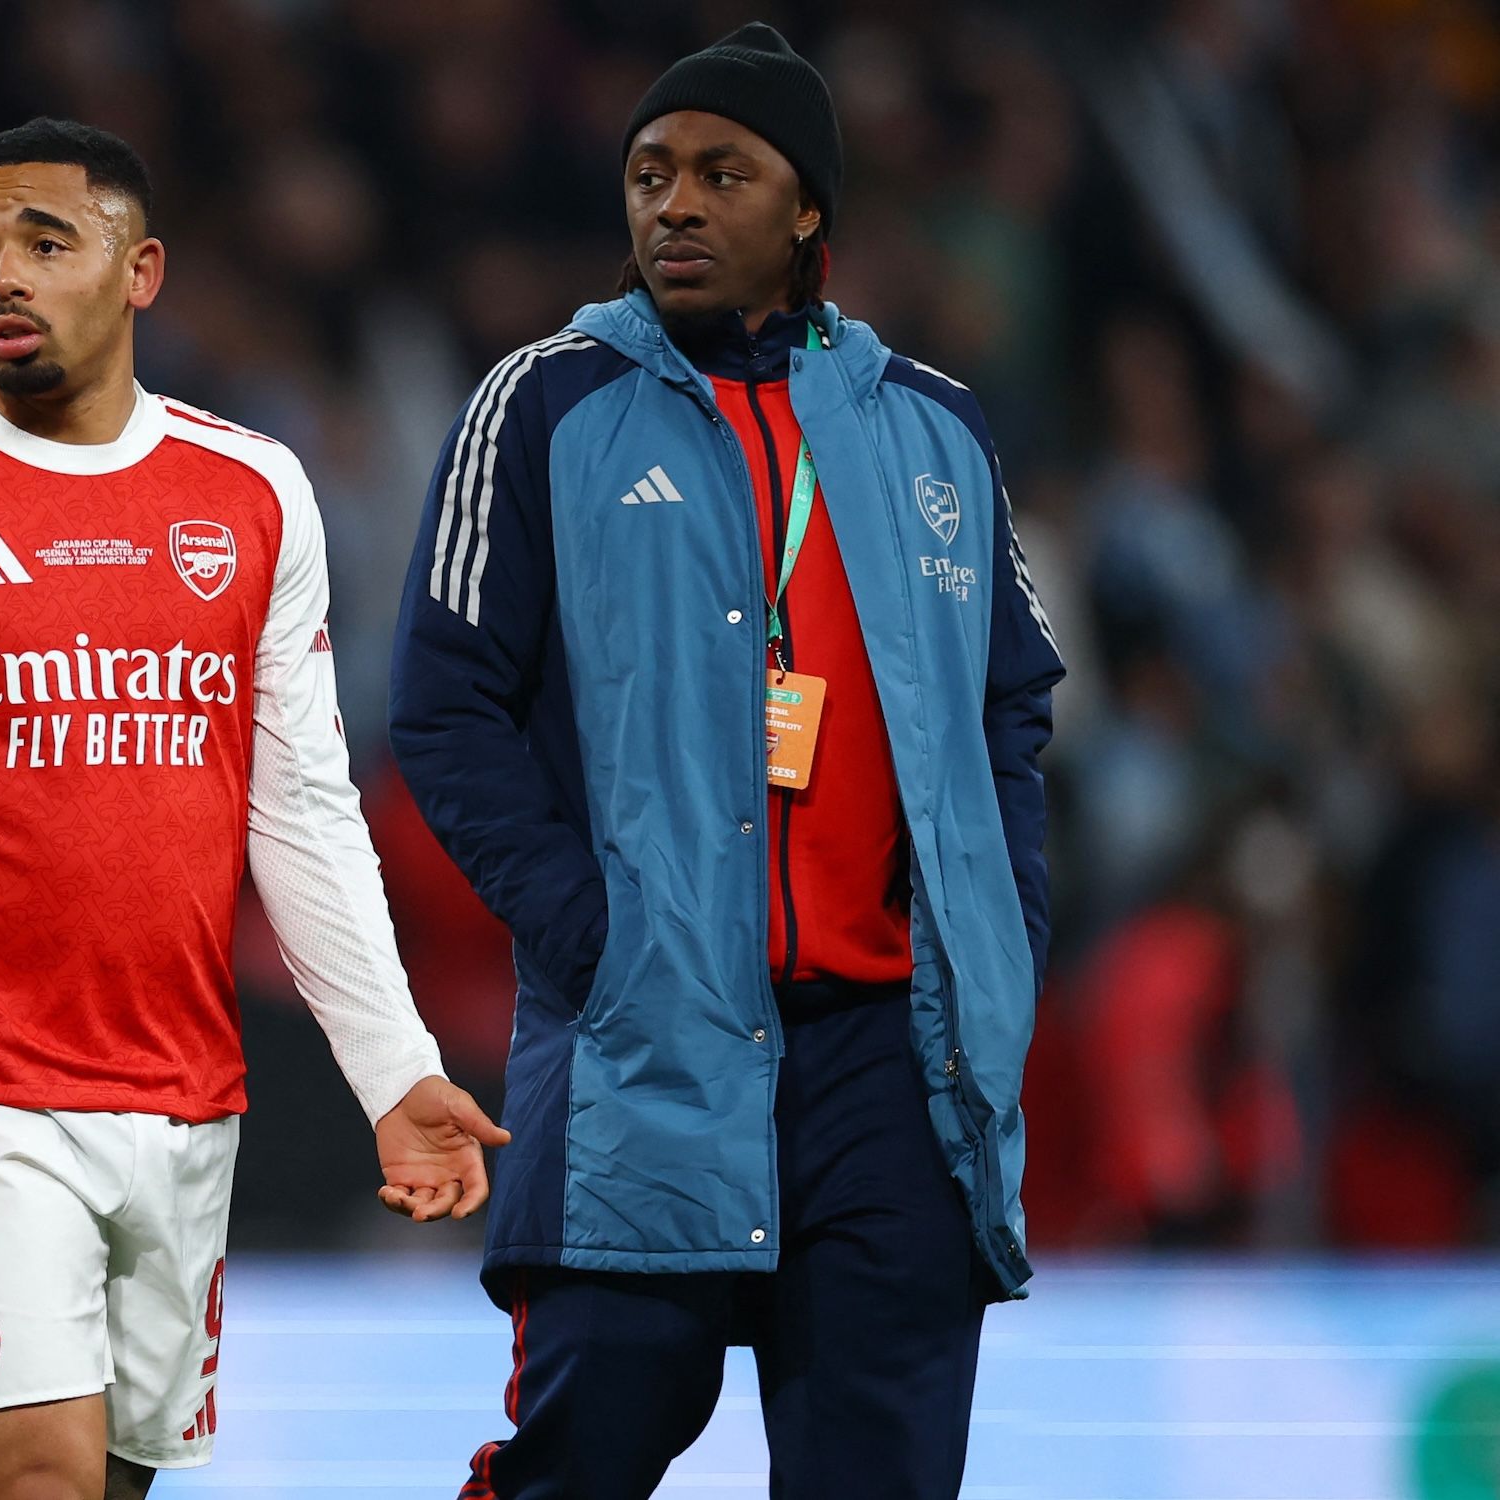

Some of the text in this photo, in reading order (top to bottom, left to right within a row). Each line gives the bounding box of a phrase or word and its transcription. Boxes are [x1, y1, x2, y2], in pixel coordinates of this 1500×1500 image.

[52, 540, 133, 549] CARABAO CUP FINAL
[179, 533, 227, 549] Arsenal
[35, 550, 71, 558] ARSENAL
[81, 549, 133, 557] MANCHESTER
[135, 549, 153, 557] CITY
[44, 557, 147, 566] SUNDAY 22ND MARCH 2026
[919, 556, 976, 584] Emtes
[6, 713, 210, 769] FLY BETTER
[767, 766, 797, 779] CCESS
